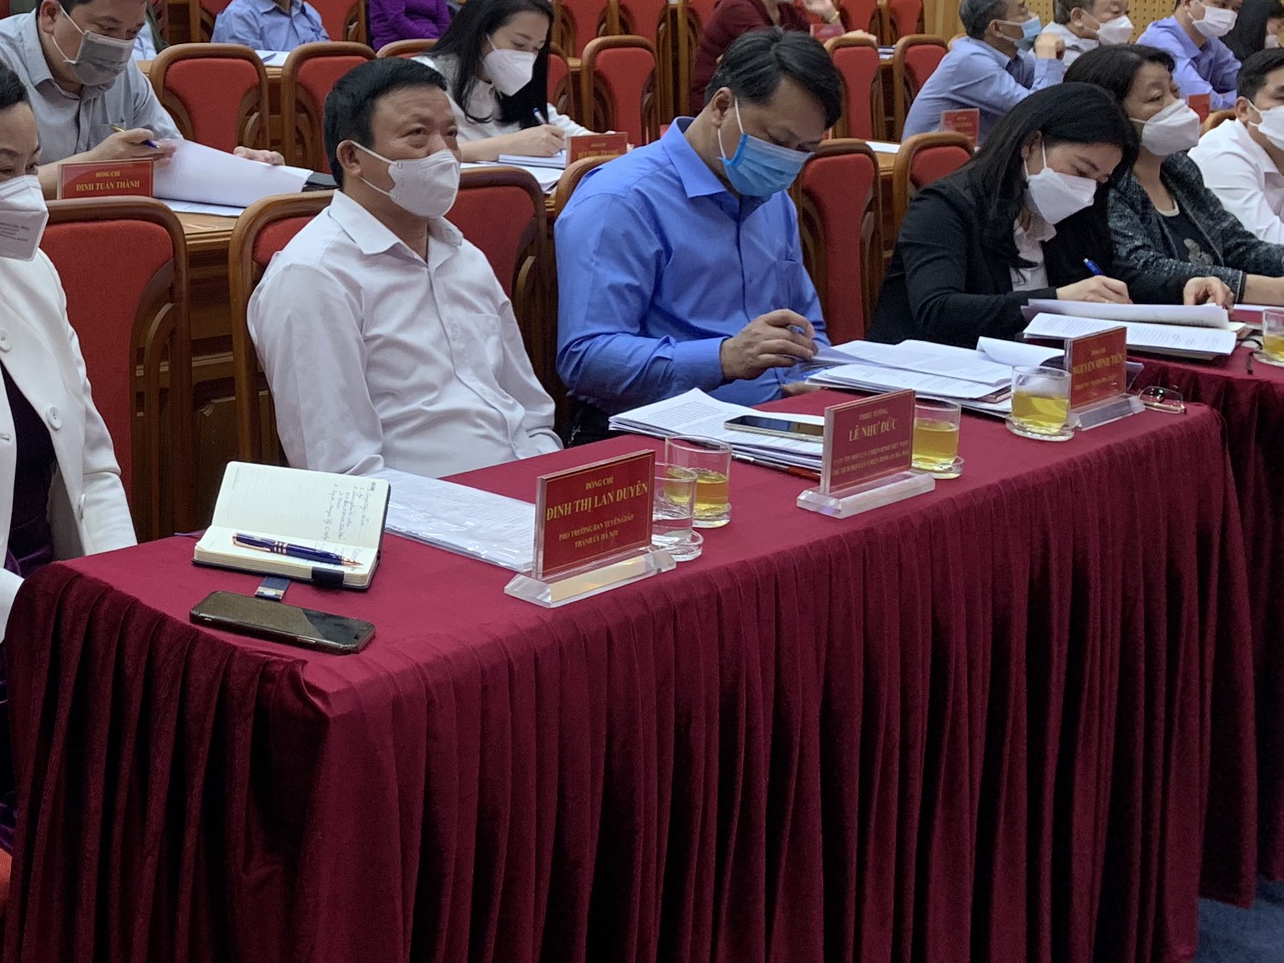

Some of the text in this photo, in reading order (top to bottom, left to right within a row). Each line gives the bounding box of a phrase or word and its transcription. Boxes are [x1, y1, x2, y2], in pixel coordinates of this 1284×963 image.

[848, 424, 860, 442] LÊ
[861, 420, 881, 437] NHƯ
[546, 480, 648, 521] ĐINH THỊ LAN DUYÊN
